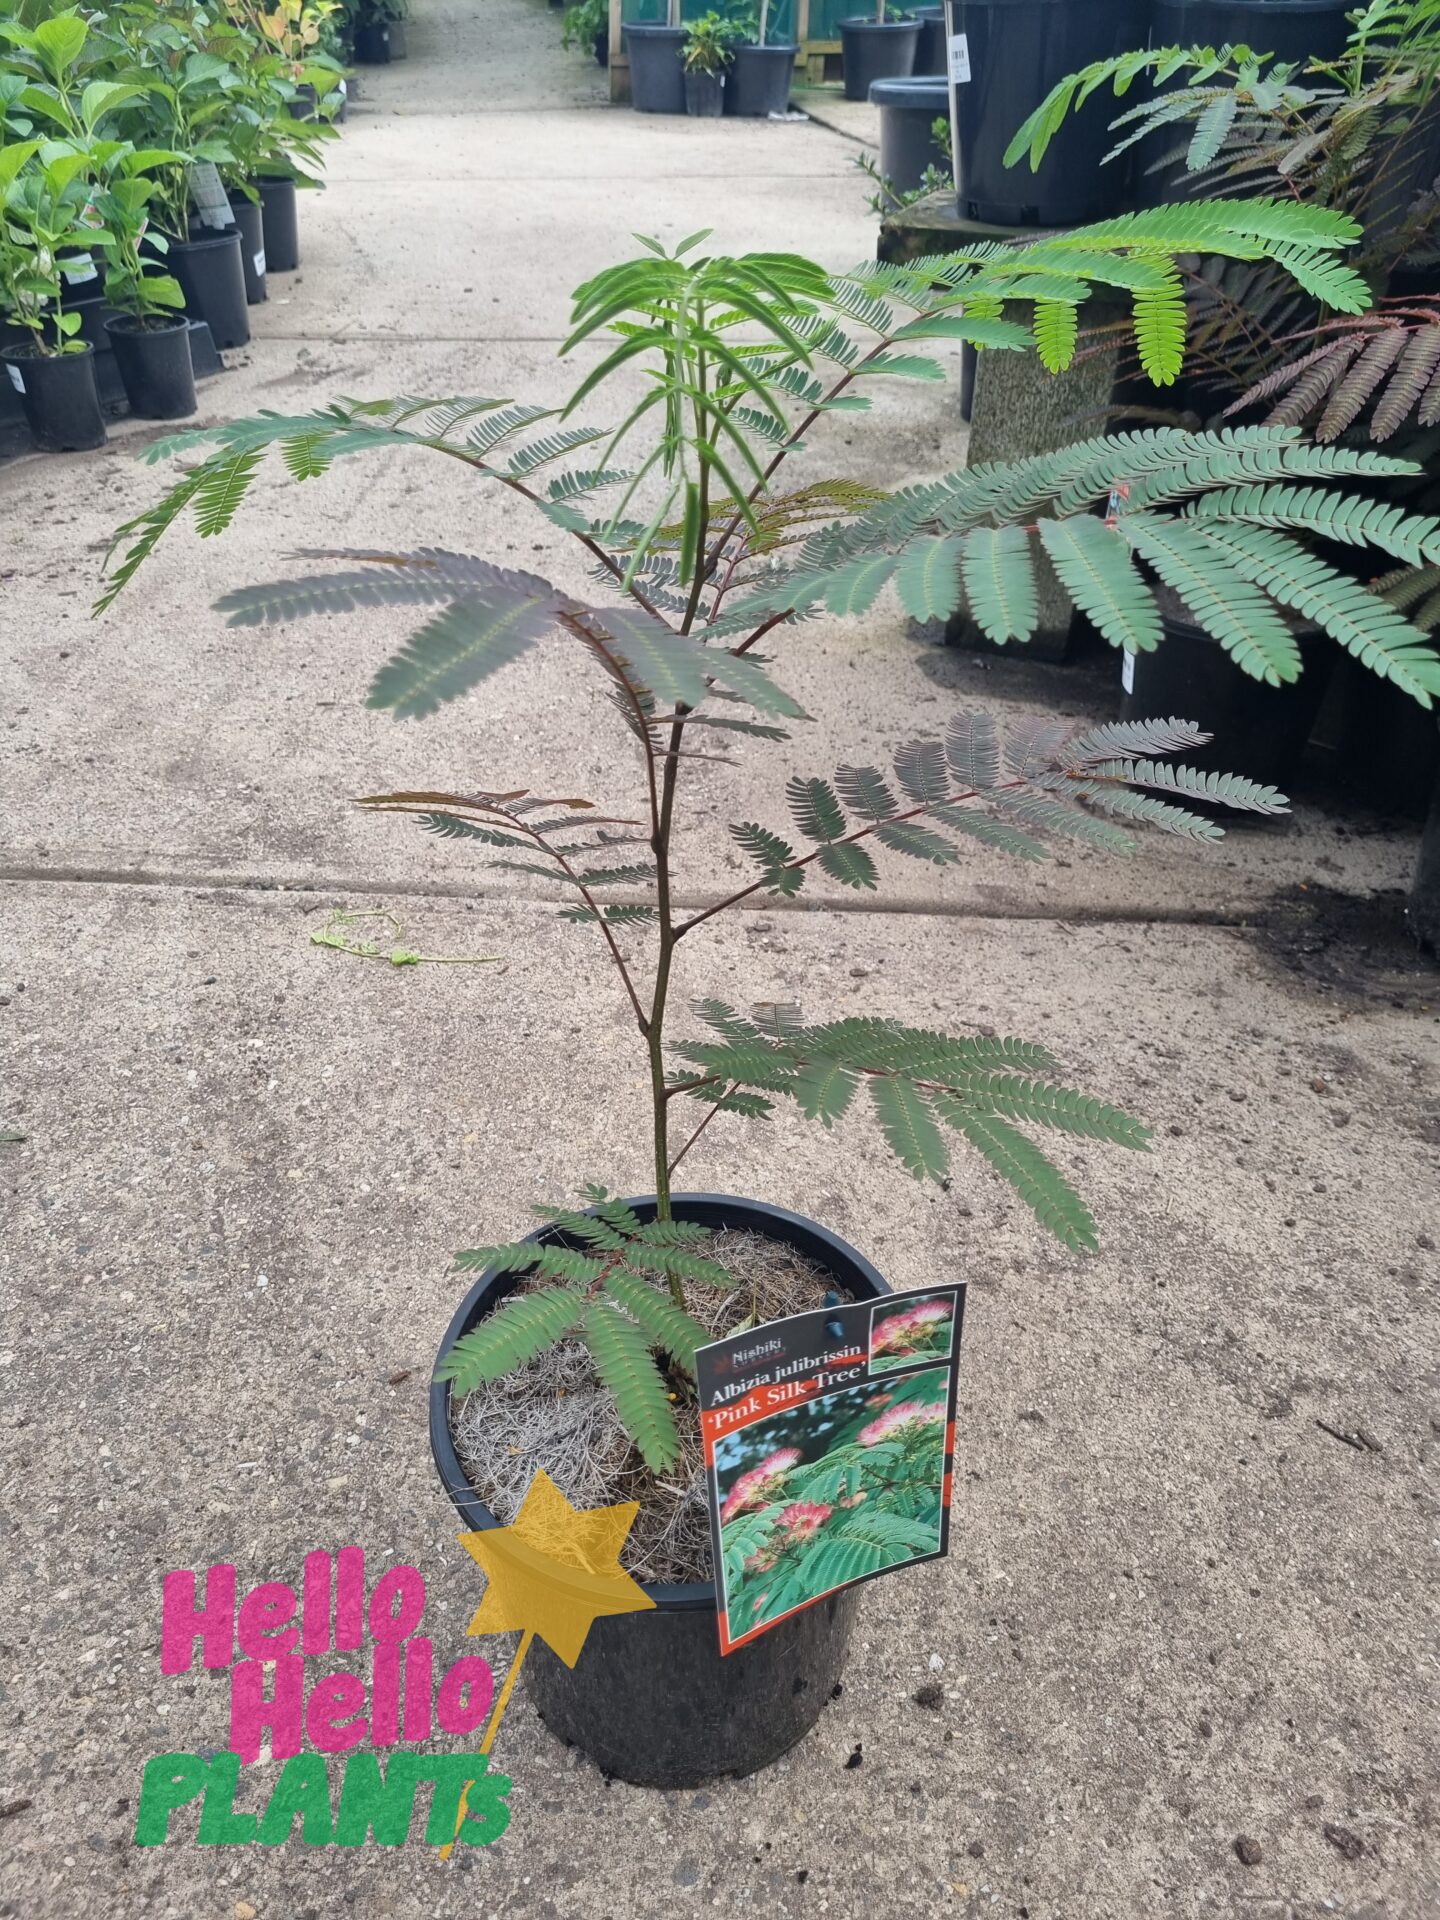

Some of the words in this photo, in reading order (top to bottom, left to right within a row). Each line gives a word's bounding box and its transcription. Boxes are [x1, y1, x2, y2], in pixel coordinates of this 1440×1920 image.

[732, 1338, 782, 1364] Nishiki
[710, 1373, 771, 1406] Albizia
[773, 1345, 861, 1384] julibrissin
[767, 1381, 806, 1405] Silk
